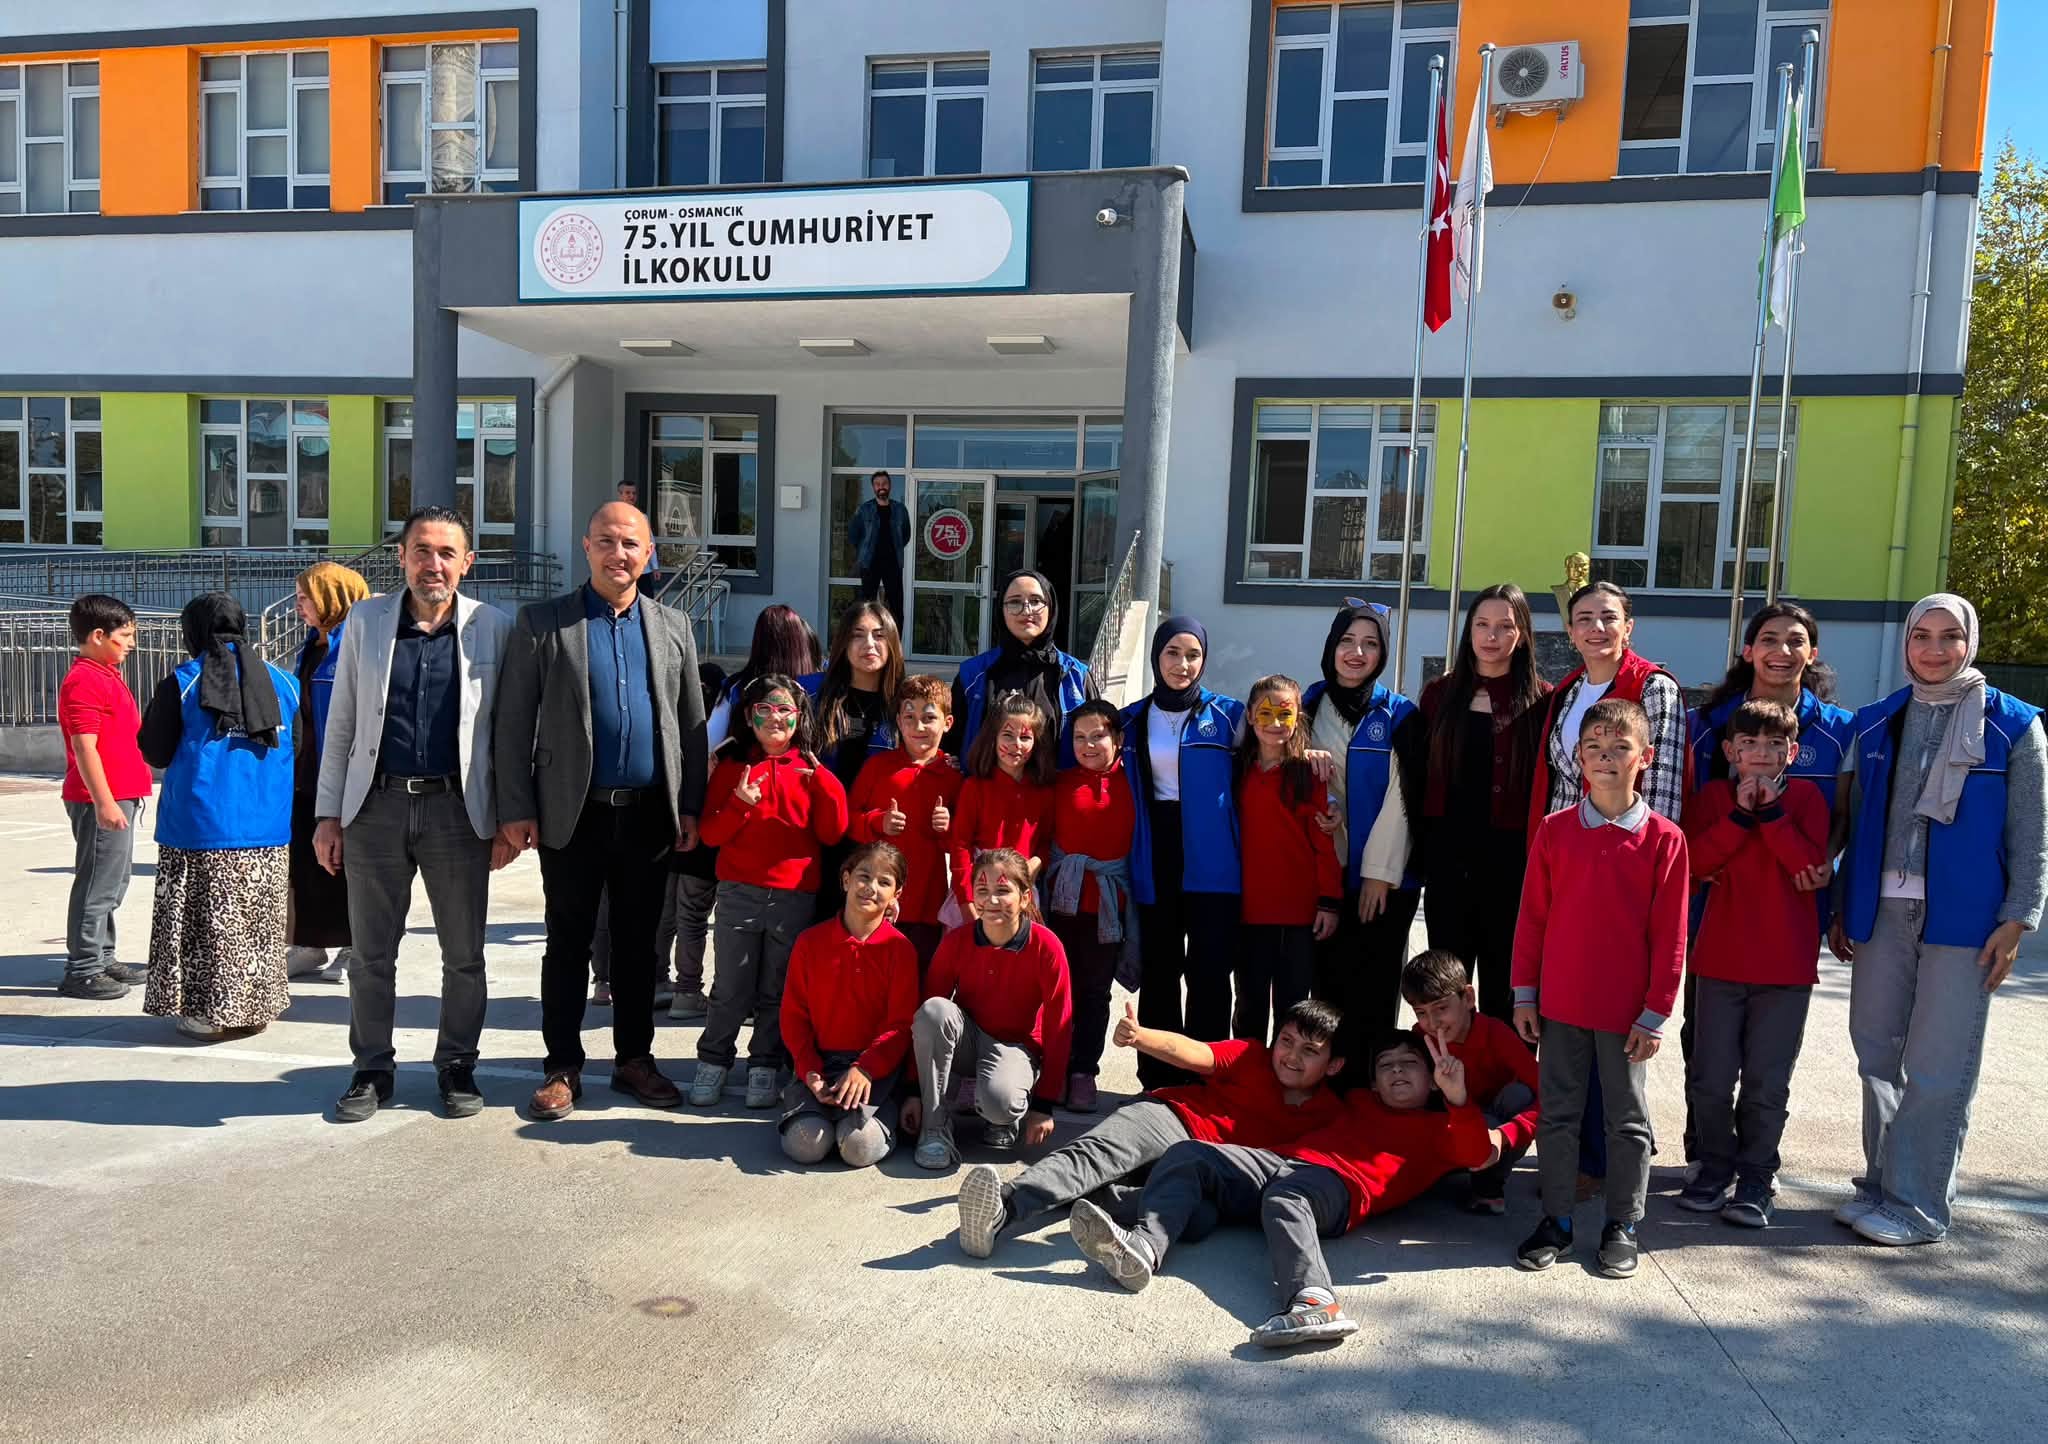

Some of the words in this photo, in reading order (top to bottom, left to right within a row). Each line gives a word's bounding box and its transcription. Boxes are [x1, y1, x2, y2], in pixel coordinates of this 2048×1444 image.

[1560, 45, 1569, 71] ALTUS
[678, 205, 744, 218] OSMANCIK
[623, 222, 715, 250] 75.YIL
[727, 209, 934, 247] CUMHURİYET
[623, 253, 771, 285] İLKOKULU
